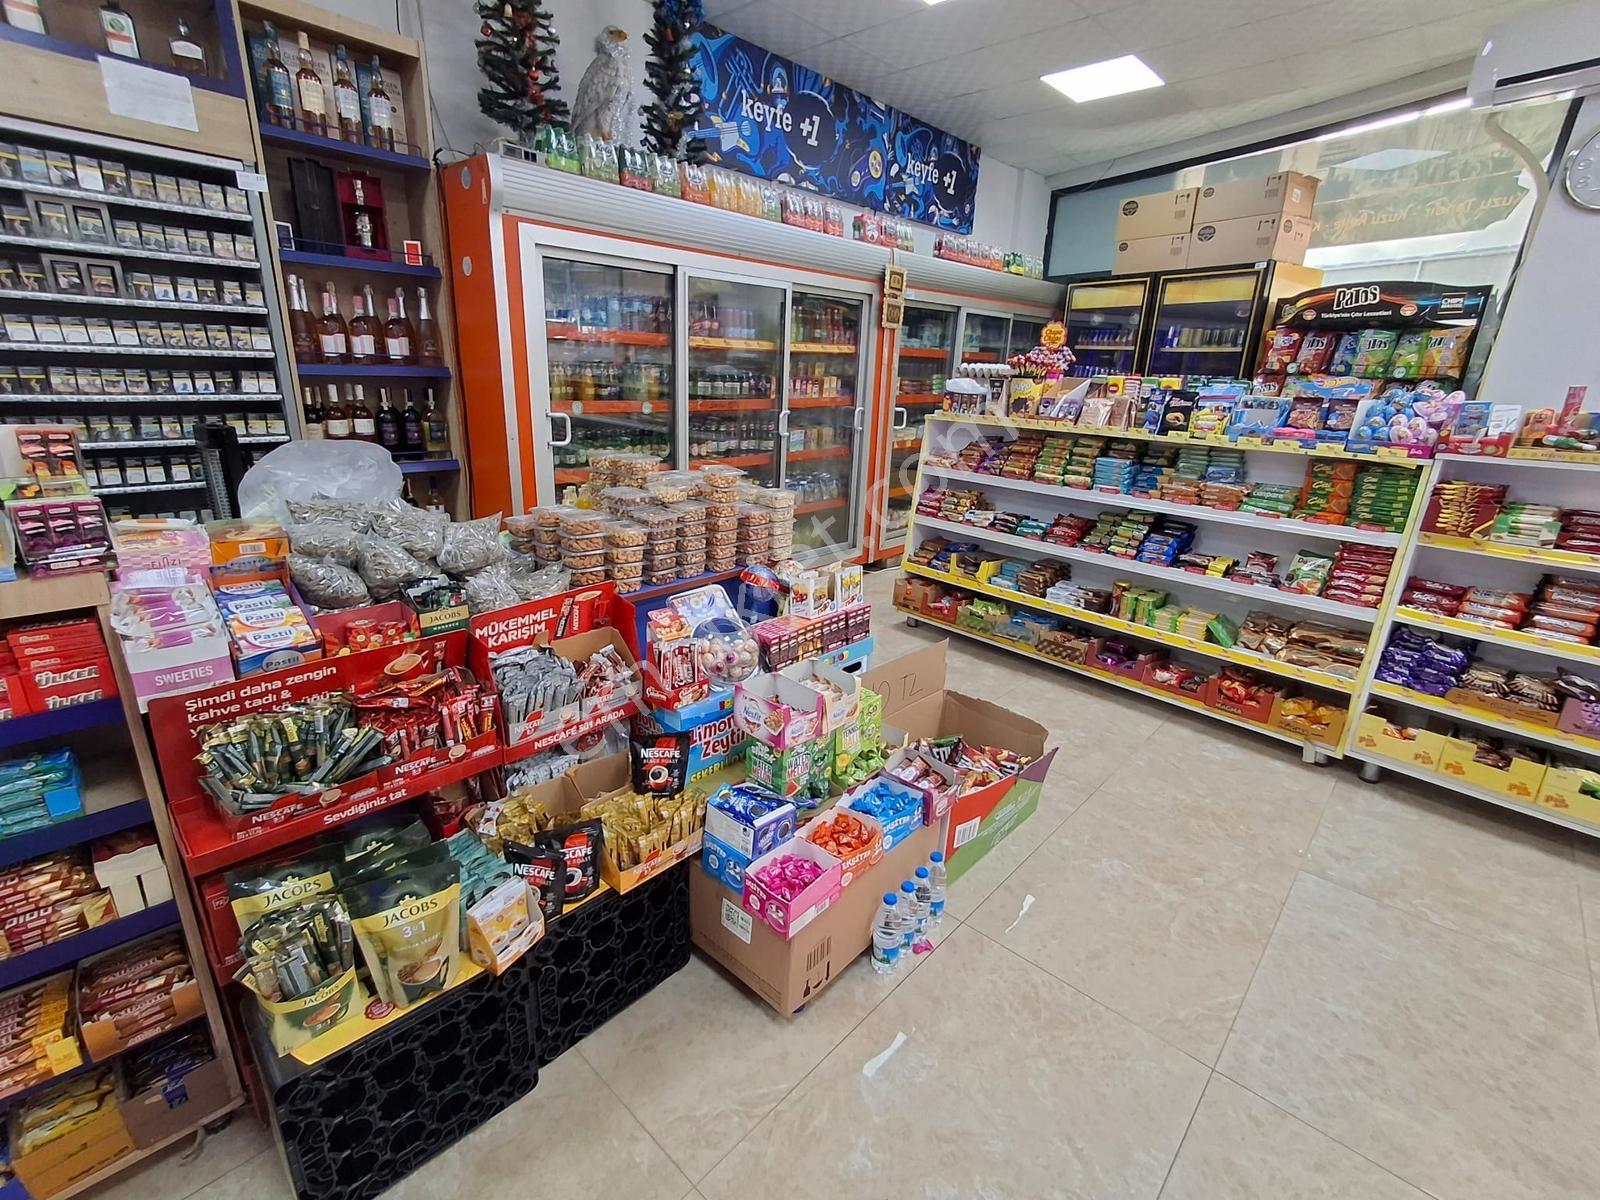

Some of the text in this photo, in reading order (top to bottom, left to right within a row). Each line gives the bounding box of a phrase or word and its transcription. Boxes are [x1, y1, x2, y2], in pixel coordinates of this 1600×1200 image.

[741, 89, 820, 148] keyfe +1
[905, 153, 956, 195] keyfe +1
[234, 600, 273, 611] Pastil
[244, 611, 285, 623] Pastil
[429, 611, 462, 624] JACOBS
[475, 608, 557, 640] MÜKEMMEL
[253, 629, 293, 642] Pastil
[487, 621, 546, 648] KARIŞIM
[266, 656, 300, 669] Pastil
[155, 665, 214, 687] SWEETIES
[184, 666, 337, 712] Şimdi daha zengin
[187, 704, 240, 724] kahve
[245, 694, 277, 710] tadı
[280, 689, 292, 699] &
[595, 708, 625, 726] ARADA
[743, 705, 762, 720] Nesfit
[787, 751, 812, 768] WATER
[323, 796, 387, 825] Sevdiğiniz
[390, 788, 407, 802] tat
[264, 879, 322, 908] JACOBS
[383, 897, 439, 928] JACOBS
[303, 984, 340, 1006] JACOBS
